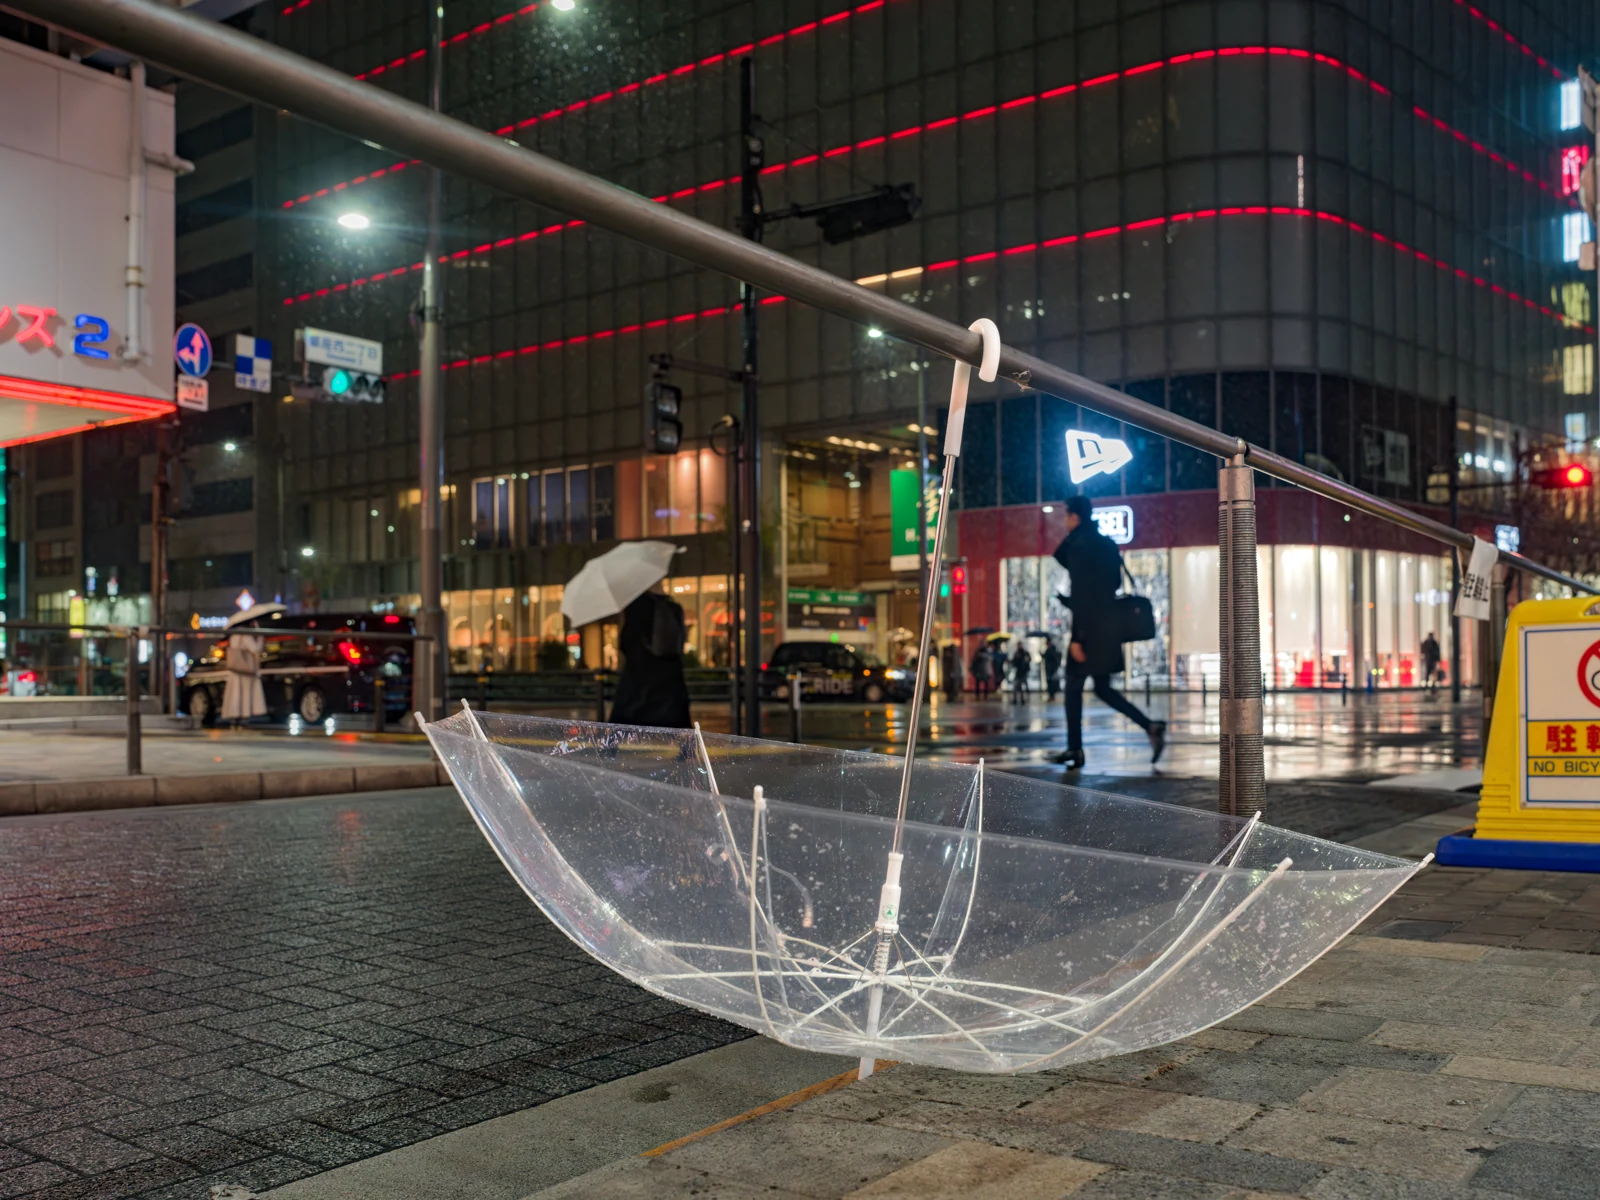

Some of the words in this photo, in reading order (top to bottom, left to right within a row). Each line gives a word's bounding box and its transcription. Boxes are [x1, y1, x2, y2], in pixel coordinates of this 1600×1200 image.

[74, 314, 110, 360] 2
[1090, 511, 1127, 536] SEL
[1533, 760, 1555, 773] NO
